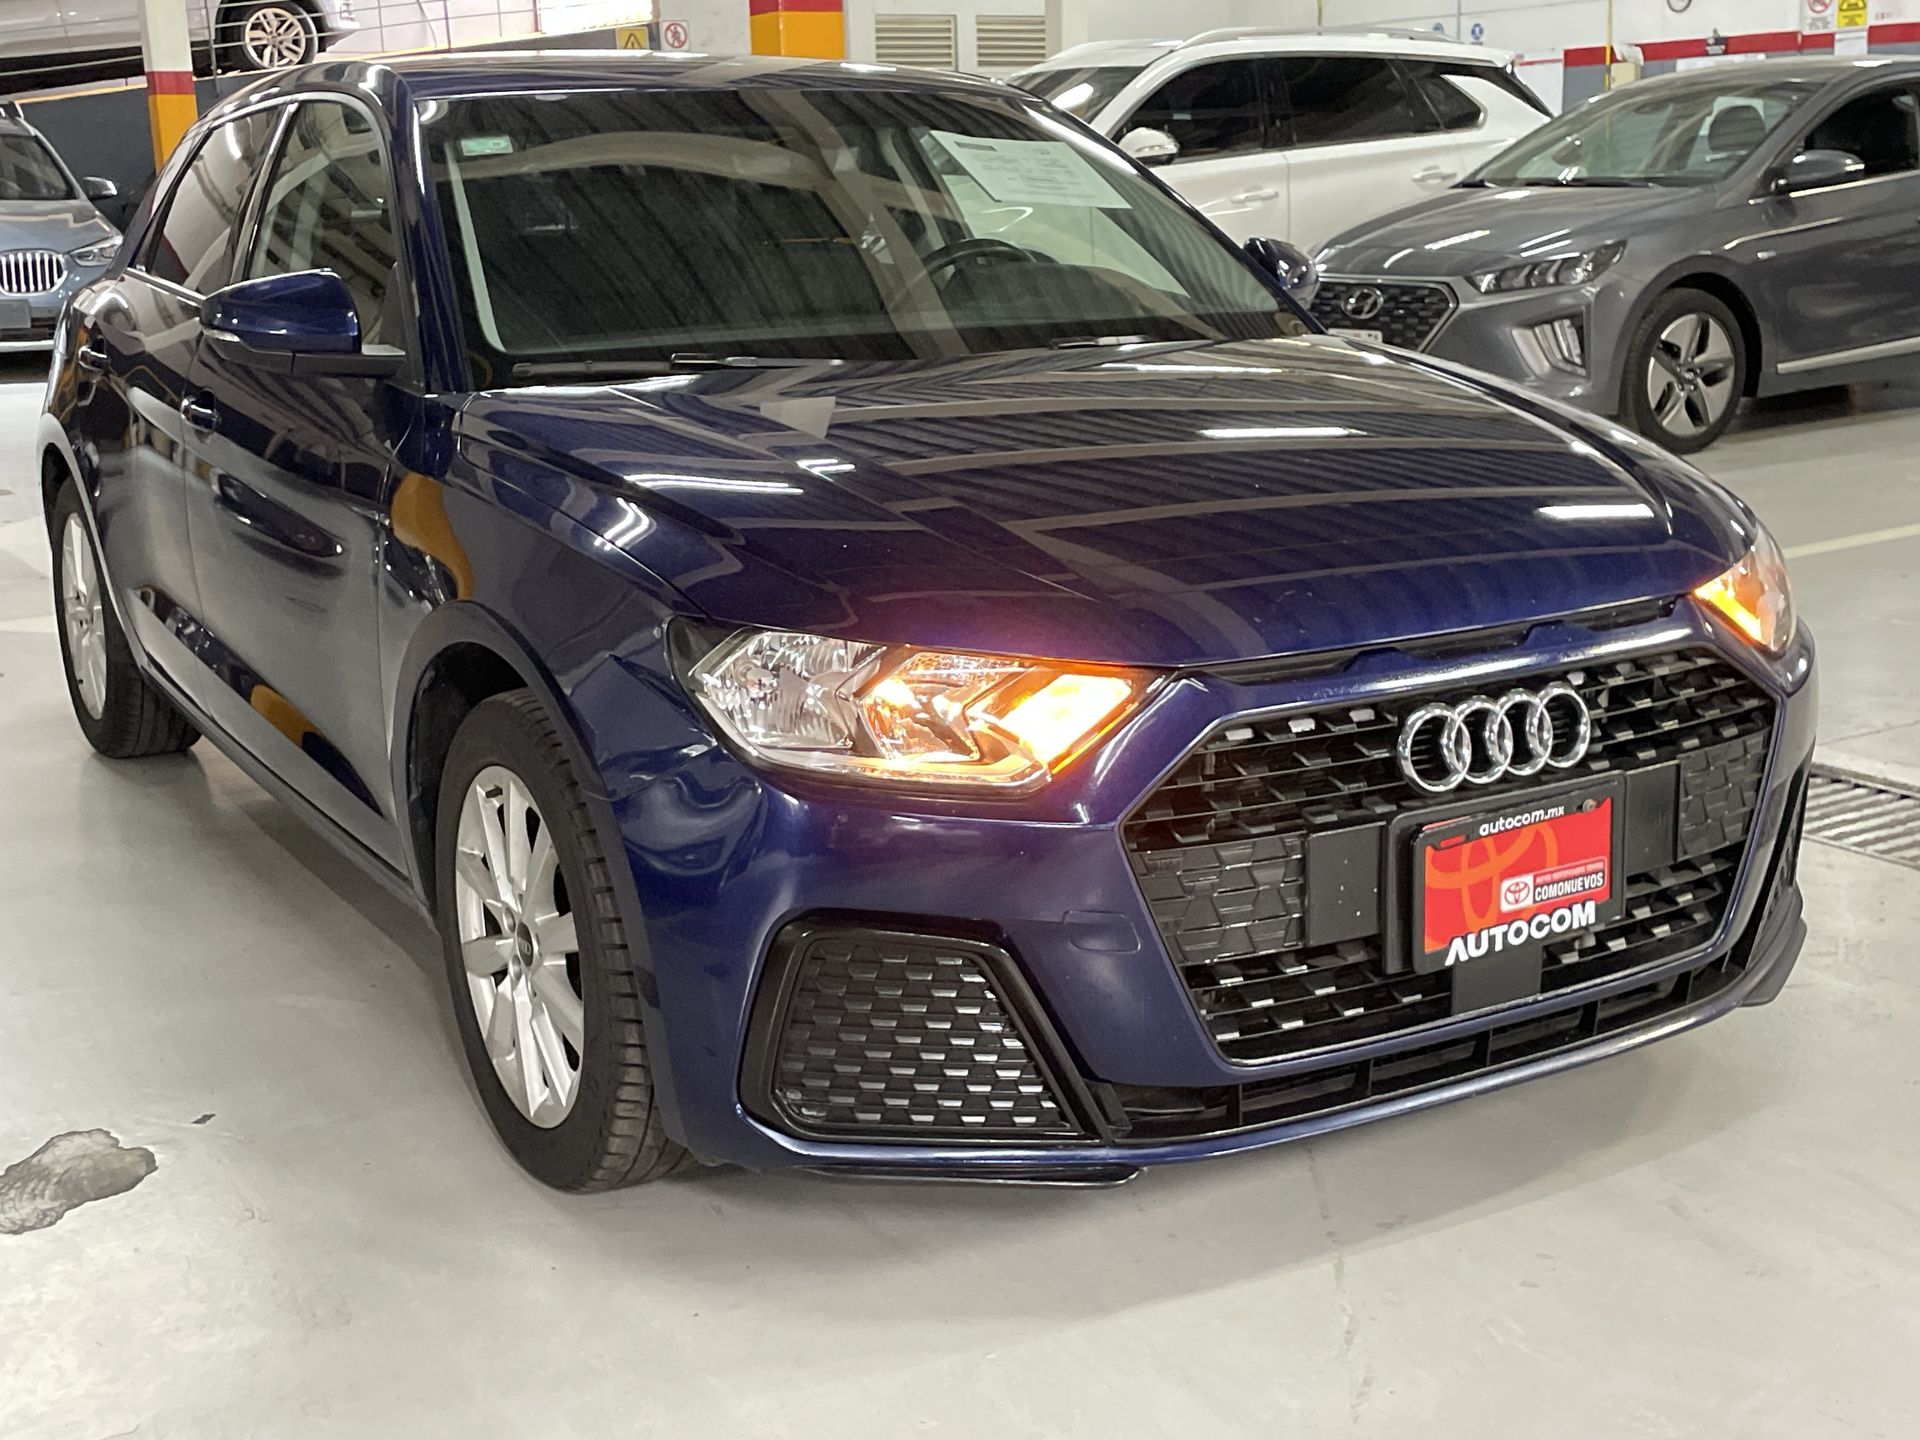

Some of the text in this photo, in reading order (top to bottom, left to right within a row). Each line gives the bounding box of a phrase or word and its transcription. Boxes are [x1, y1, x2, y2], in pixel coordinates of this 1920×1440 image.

[1479, 806, 1565, 836] autocom.mx
[1535, 872, 1603, 902] COMONUEVOS
[1444, 902, 1596, 966] AUTOCOM
